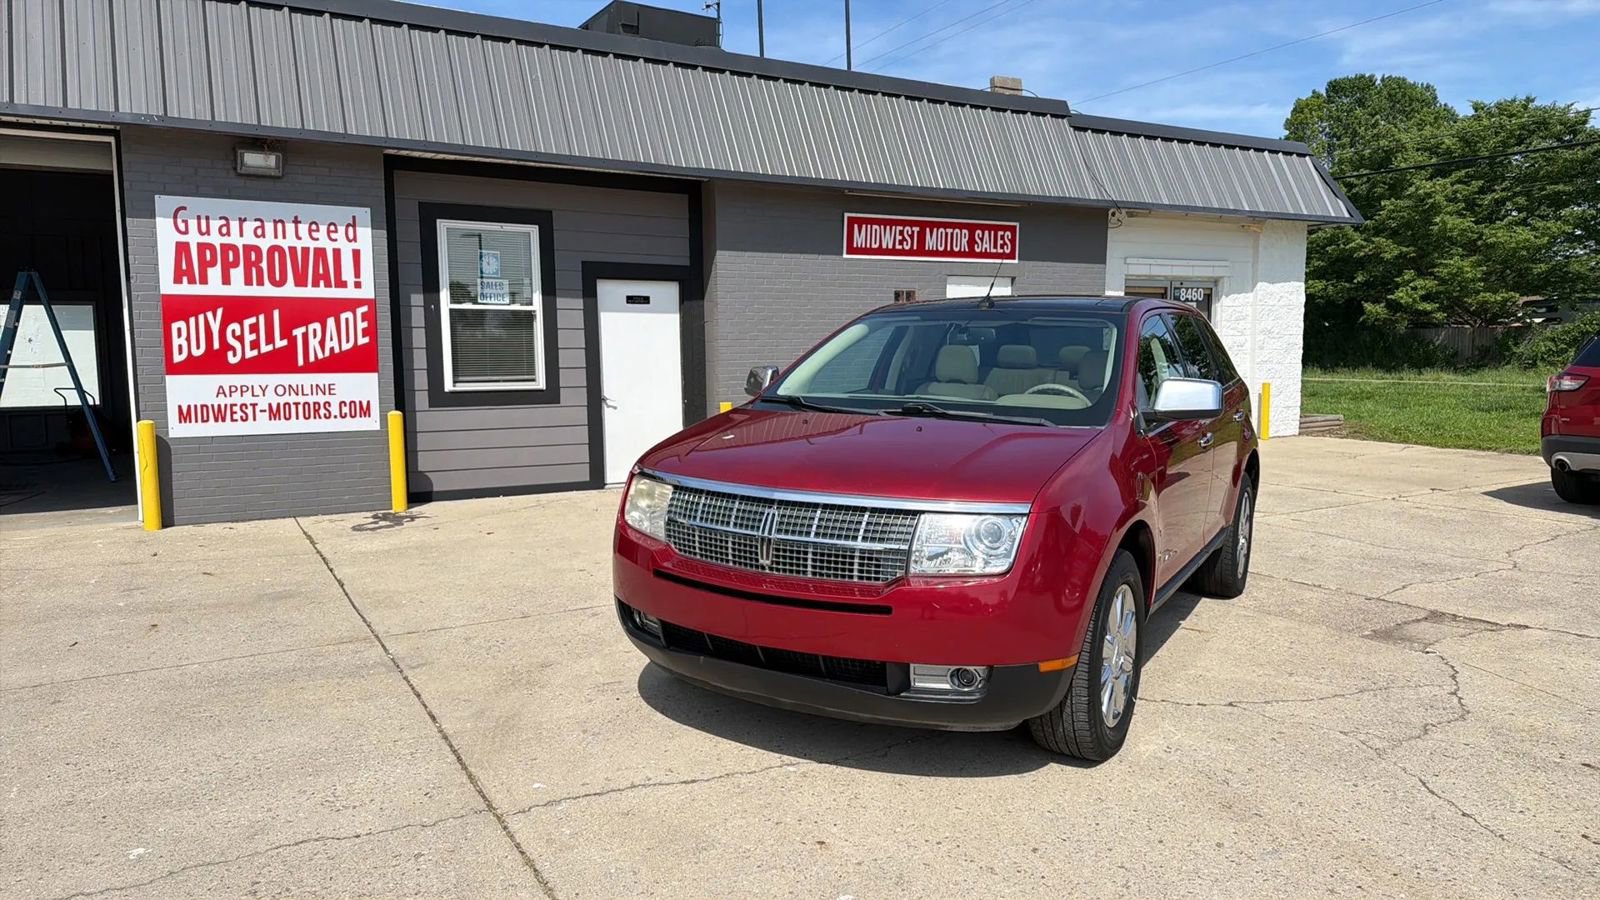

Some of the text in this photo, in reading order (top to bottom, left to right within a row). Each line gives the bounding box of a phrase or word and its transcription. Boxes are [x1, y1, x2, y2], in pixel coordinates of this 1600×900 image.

[172, 206, 358, 243] Guaranteed
[853, 223, 1012, 254] MIDWEST MOTOR SALES
[172, 241, 362, 289] APPROVAL!
[480, 281, 504, 291] SALES
[480, 292, 506, 301] OFFICE
[1180, 287, 1204, 301] 8460
[171, 305, 370, 367] BUY SELL TRADE
[215, 383, 337, 398] APPLY ONLINE
[177, 400, 372, 424] MIDWEST-MOTORS.COM
